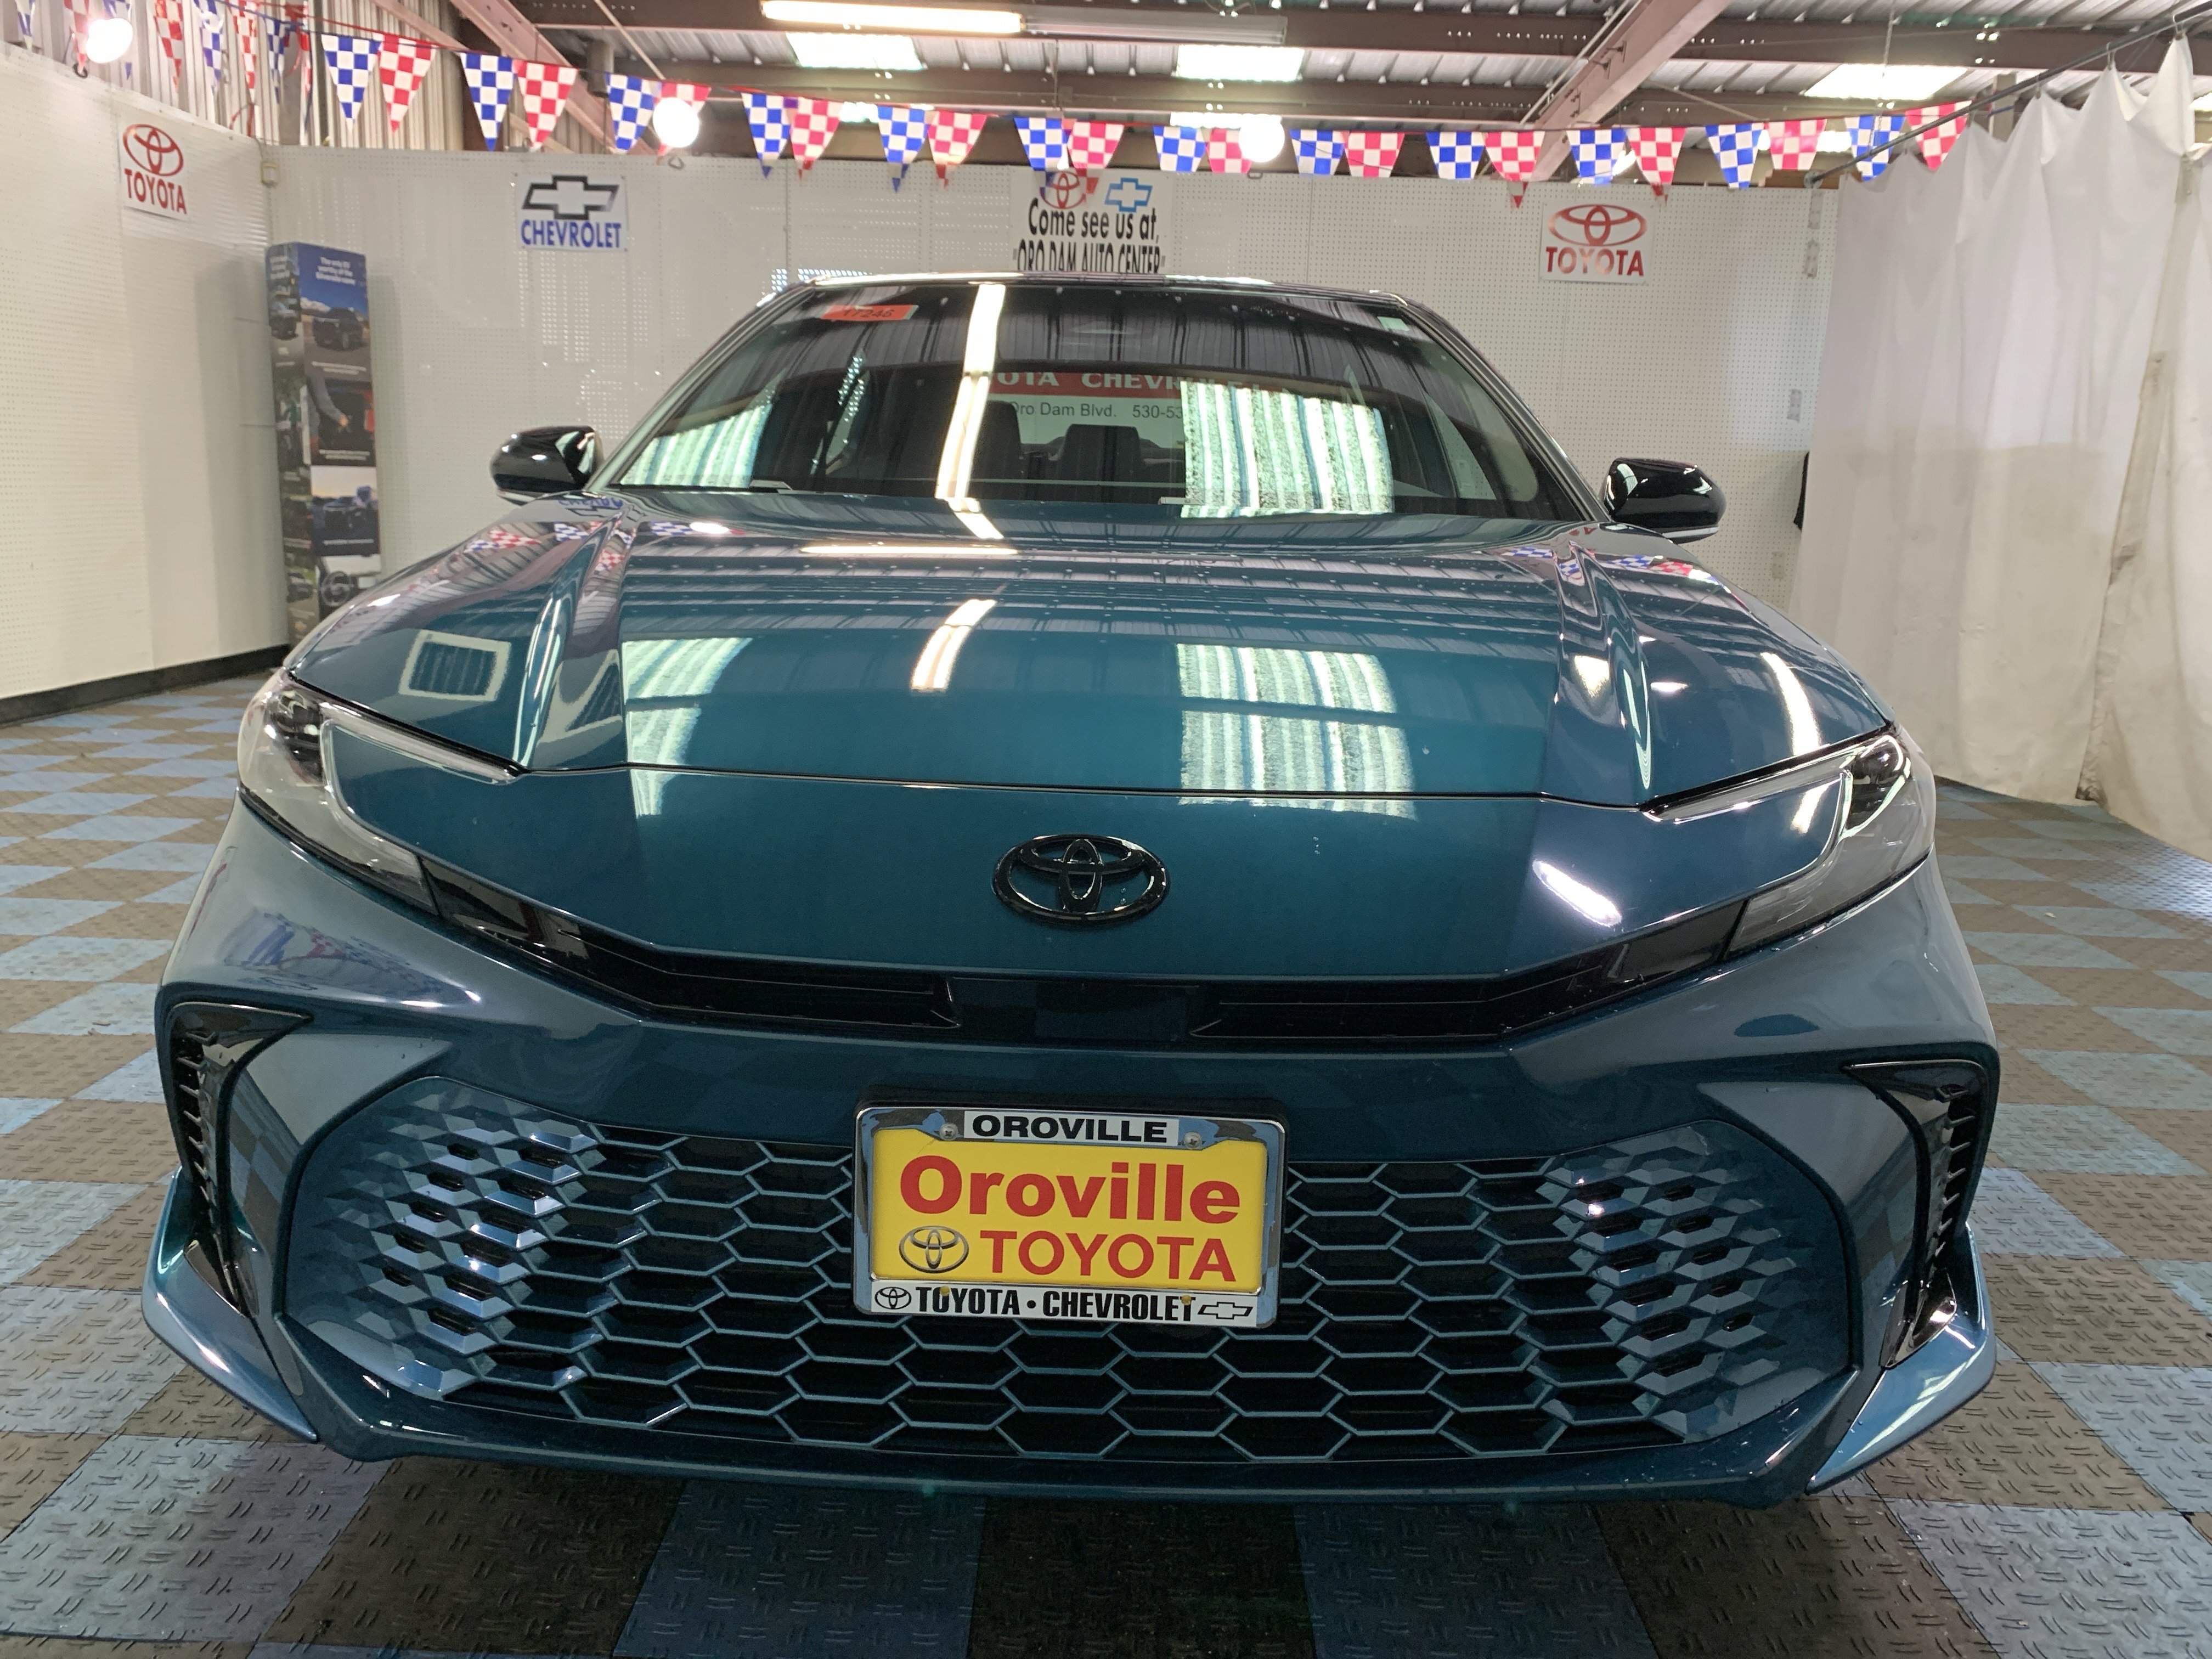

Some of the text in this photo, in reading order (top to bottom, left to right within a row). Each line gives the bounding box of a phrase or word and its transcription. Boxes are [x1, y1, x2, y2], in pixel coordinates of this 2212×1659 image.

[124, 168, 187, 214] TOYOTA
[521, 219, 622, 248] CHEVROLET
[1029, 198, 1075, 237] Come
[1081, 211, 1109, 239] see
[1115, 212, 1133, 240] us
[1018, 239, 1160, 274] ORO DAM AUTO CENTER
[1545, 246, 1644, 276] TOYOTA
[997, 372, 1060, 387] OTA
[1040, 402, 1075, 416] Dam
[1081, 403, 1116, 418] Blvd.
[1132, 404, 1183, 419] 530-53
[972, 1115, 1167, 1143] OROVILLE
[900, 1155, 1240, 1224] Oroville
[980, 1229, 1237, 1282] TOYOTA
[916, 1286, 1196, 1322] TOYOTA CHEVROLET
